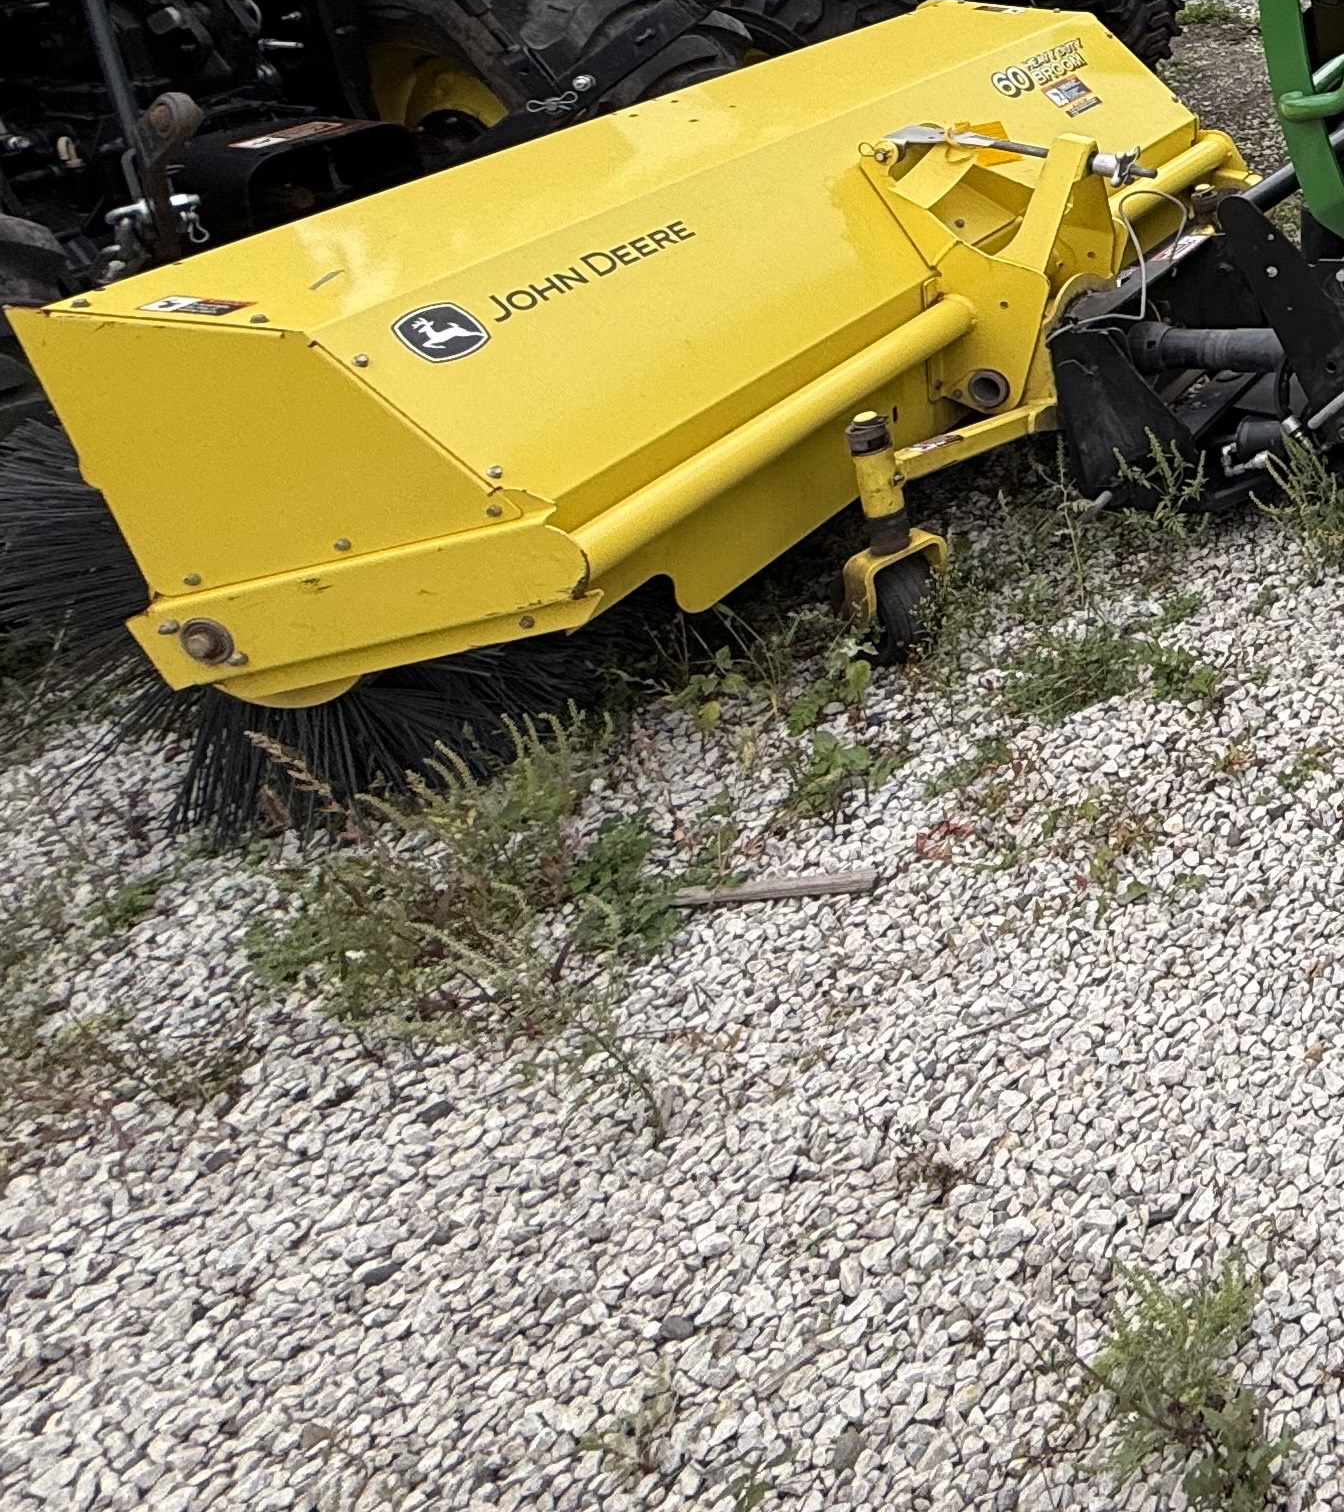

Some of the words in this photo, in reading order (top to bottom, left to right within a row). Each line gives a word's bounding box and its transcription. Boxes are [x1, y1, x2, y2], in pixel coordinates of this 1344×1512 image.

[990, 65, 1035, 99] 60
[1030, 51, 1089, 87] BROOM
[1021, 49, 1058, 72] HEAVY
[1055, 36, 1084, 58] DUTY
[488, 266, 590, 323] JOHN
[579, 220, 697, 277] DEERE
